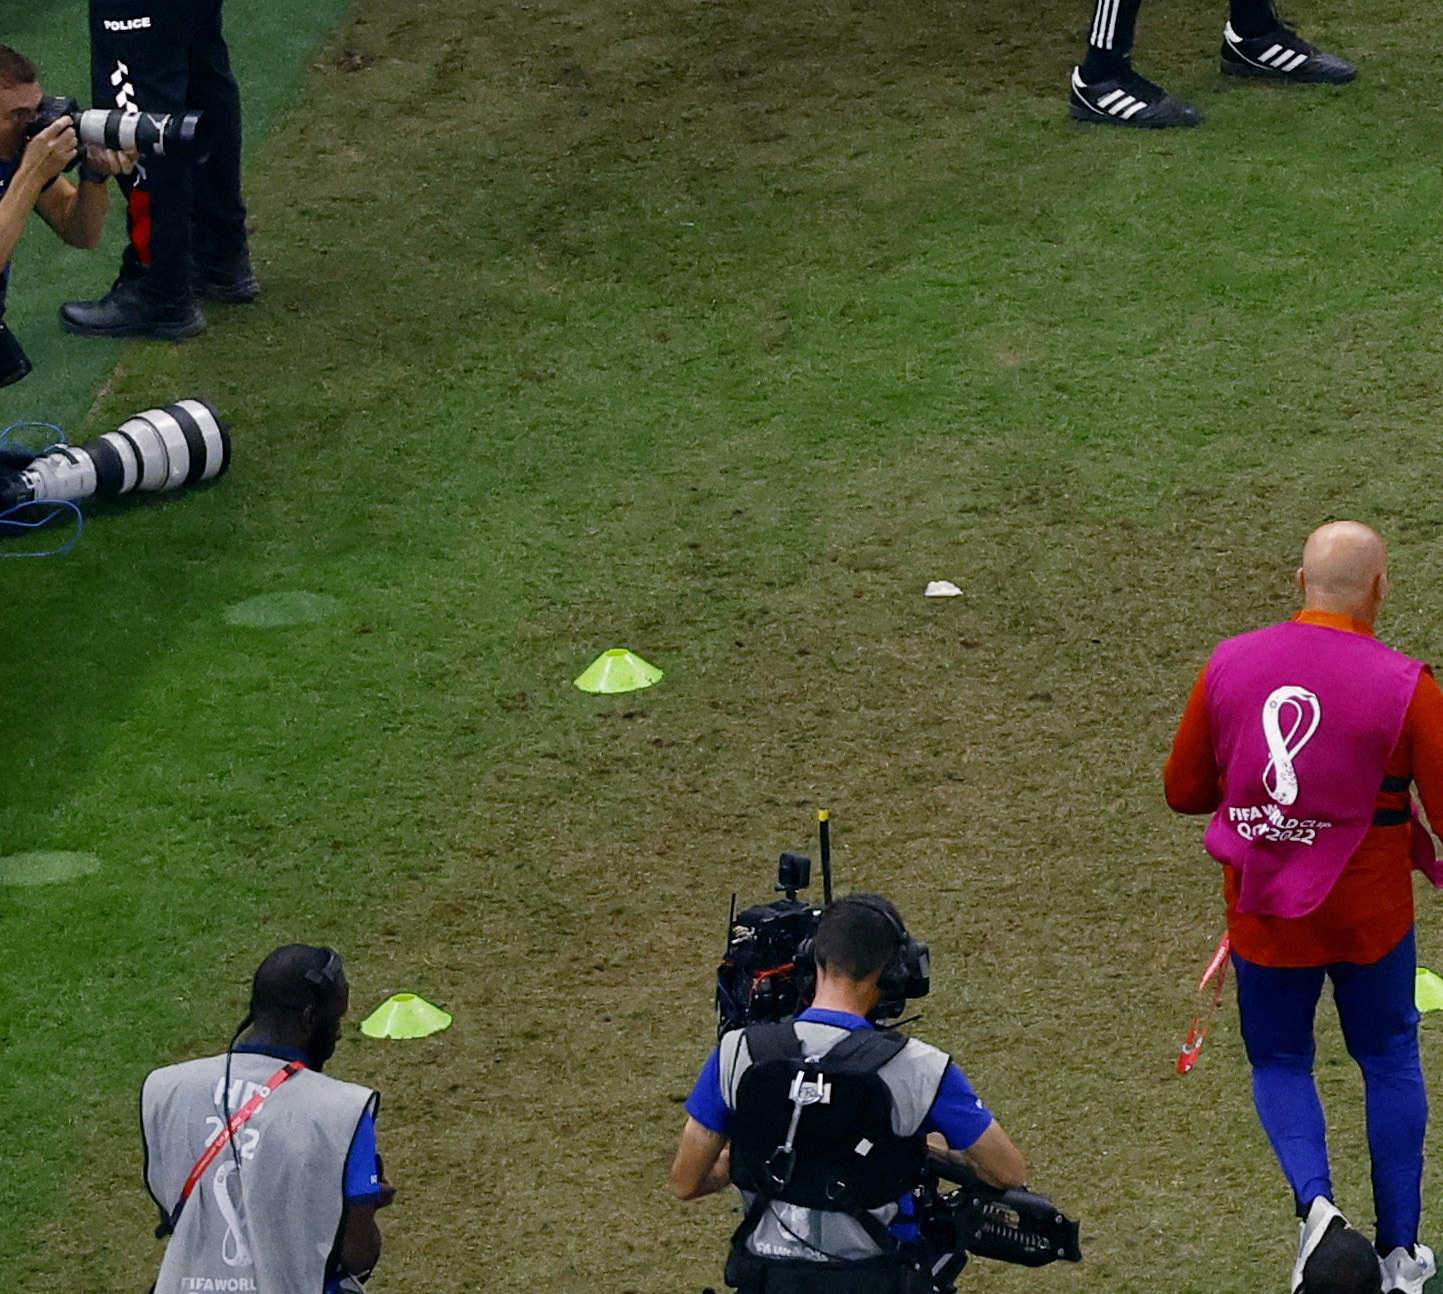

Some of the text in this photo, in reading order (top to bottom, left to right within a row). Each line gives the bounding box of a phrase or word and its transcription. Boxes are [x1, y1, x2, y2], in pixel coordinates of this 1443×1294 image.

[103, 17, 151, 32] POLICE
[181, 1277, 257, 1292] FIFA WORL
